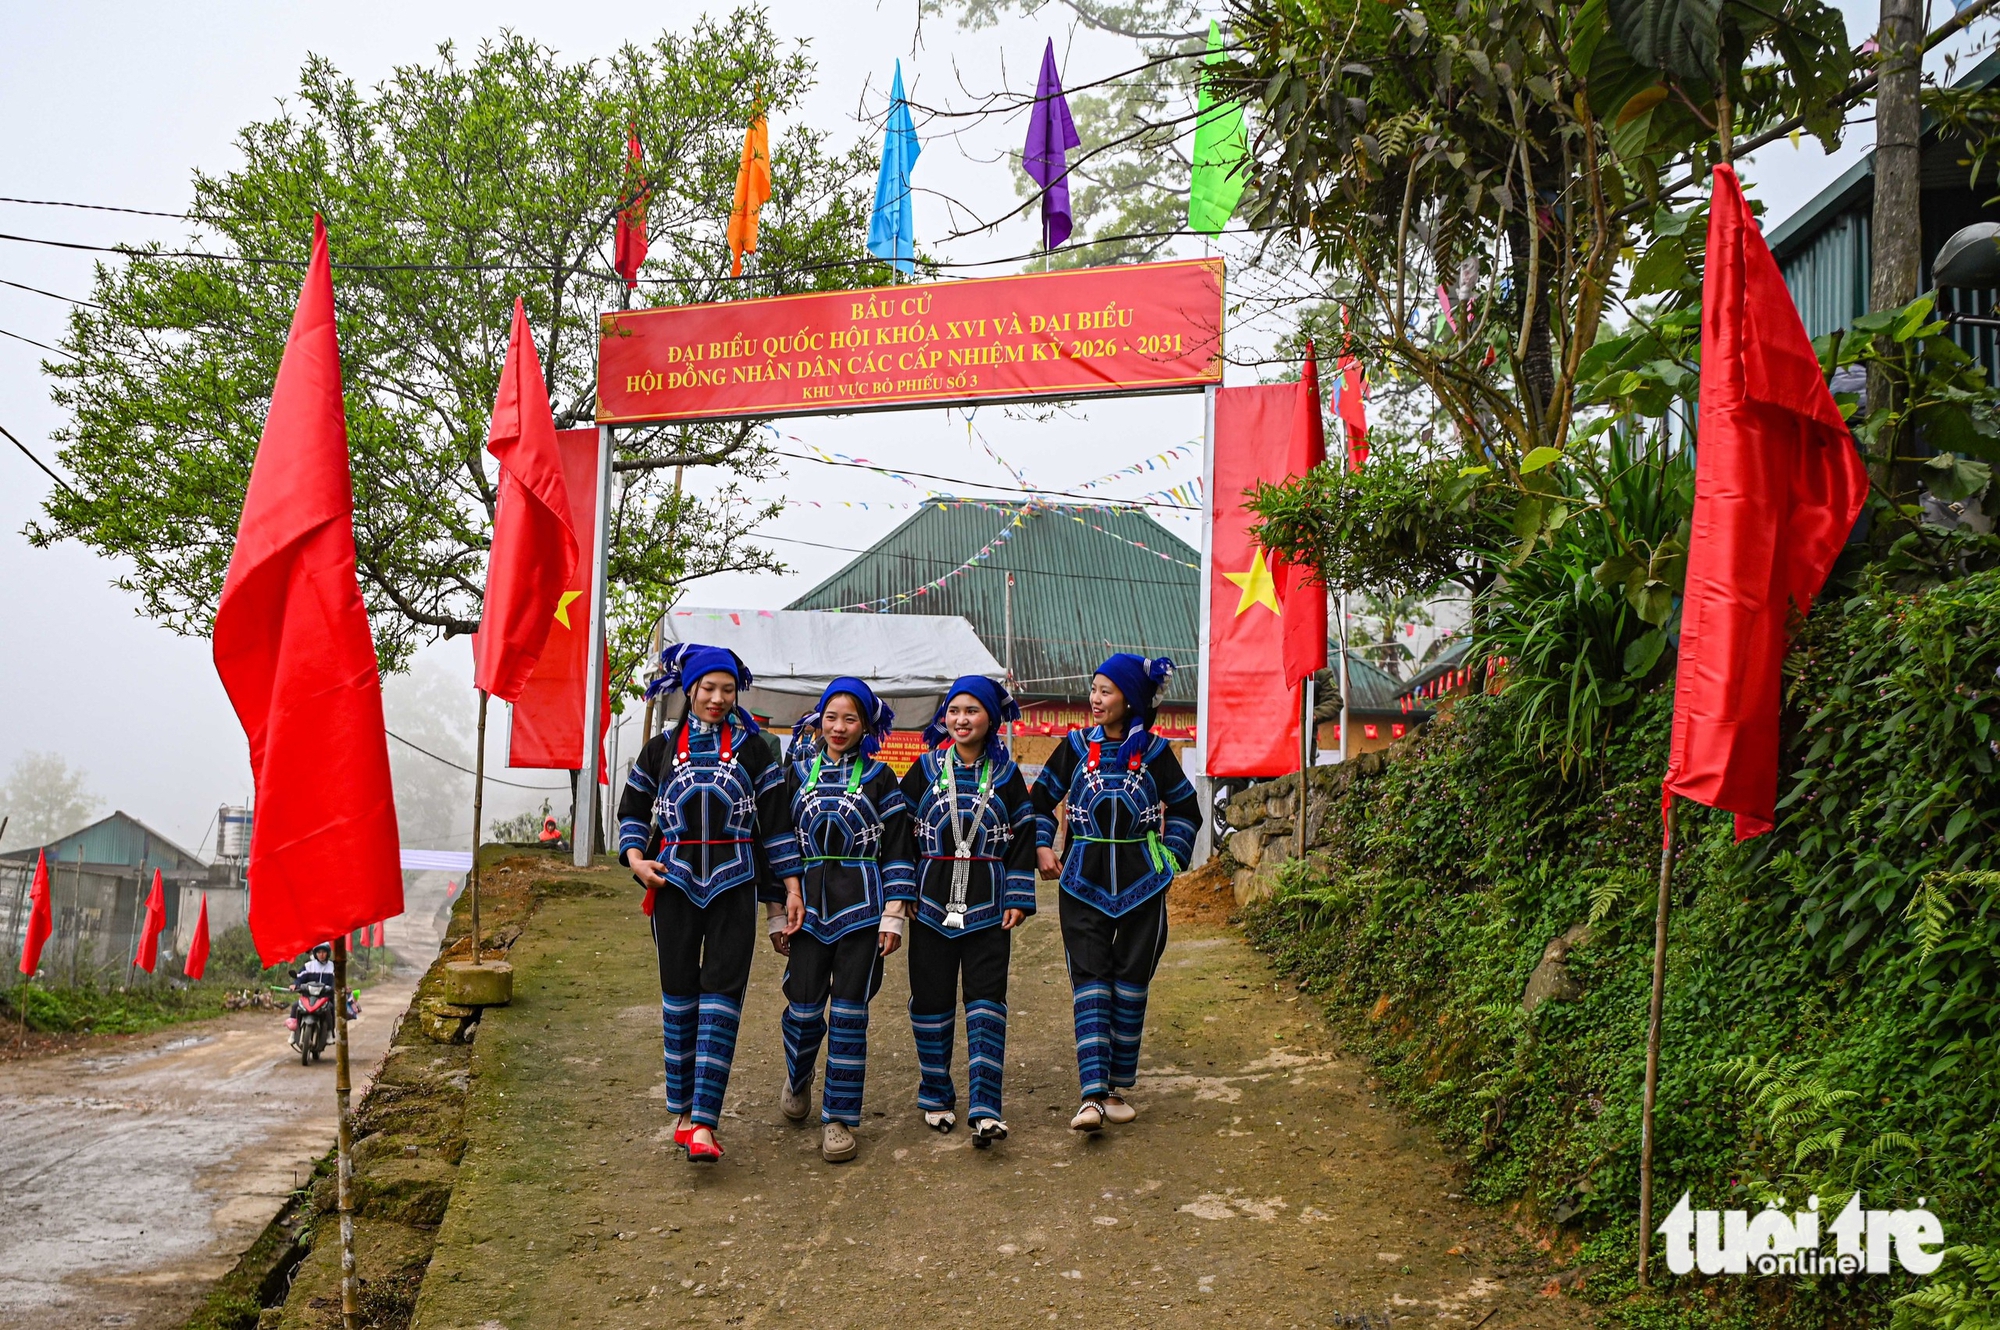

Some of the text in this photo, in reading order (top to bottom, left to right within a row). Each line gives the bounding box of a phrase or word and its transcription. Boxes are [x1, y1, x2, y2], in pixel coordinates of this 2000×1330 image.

[851, 291, 933, 320] BẦU CỬ
[668, 301, 1134, 367] ĐẠI BIỂU QUỐC HỘI KHÓA XVI VÀ ĐẠI BIỂU
[626, 369, 663, 395] HỘI
[668, 362, 727, 390] ĐỒNG
[732, 359, 792, 384] NHÂN
[797, 355, 842, 379] DÂN
[847, 351, 893, 374] CÁC
[898, 343, 943, 371] CẤP
[947, 340, 1025, 369] NHIỆM
[1032, 339, 1063, 362] KỲ
[1070, 338, 1117, 359] 2026
[1137, 333, 1183, 355] 2031
[802, 371, 978, 400] KHU VỰC BỎ PHIẾU SỐ 3
[1036, 710, 1055, 727] LAO
[1058, 708, 1085, 728] ĐỘNG
[904, 742, 920, 750] SÁCH
